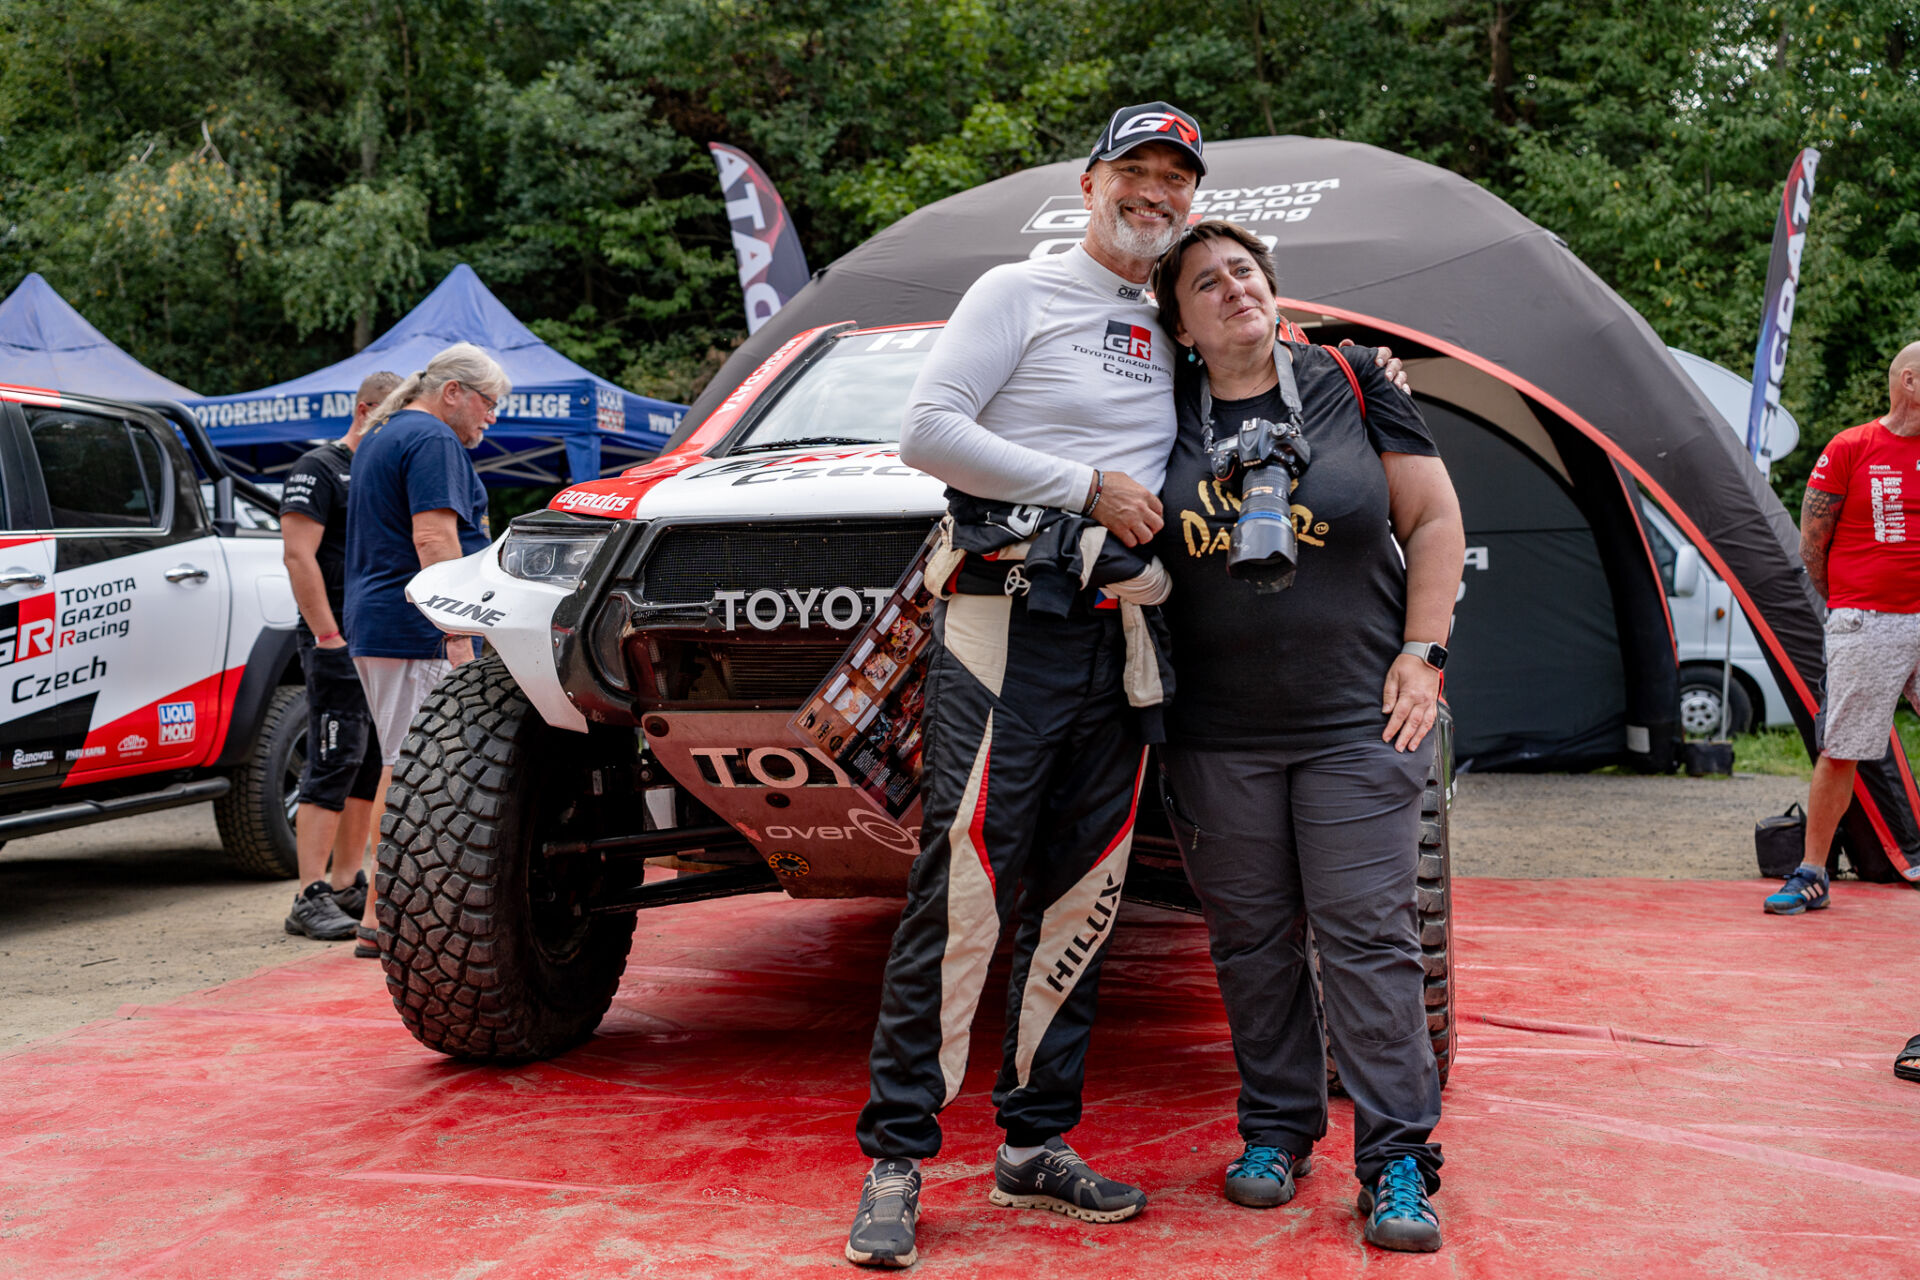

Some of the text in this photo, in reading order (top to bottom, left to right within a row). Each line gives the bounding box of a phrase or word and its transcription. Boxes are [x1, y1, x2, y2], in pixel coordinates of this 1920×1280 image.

[1115, 112, 1198, 145] GR
[1193, 178, 1340, 201] TOYOTA
[1190, 193, 1321, 213] GAZOO
[1072, 344, 1115, 361] TOYOTA
[1117, 356, 1151, 370] GAZOO
[1105, 333, 1151, 359] GR
[1103, 363, 1153, 383] Czech
[190, 393, 310, 428] OTORENÖLE
[731, 464, 931, 486] Czec
[556, 490, 635, 511] agados
[61, 577, 136, 606] TOYOTA
[61, 598, 131, 627] GAZOO
[419, 594, 506, 627] XTLINE
[59, 619, 130, 648] Racing
[11, 655, 107, 704] Czech
[161, 705, 193, 722] LIQUI
[162, 722, 194, 741] MOLY
[1046, 873, 1121, 993] HILUX
